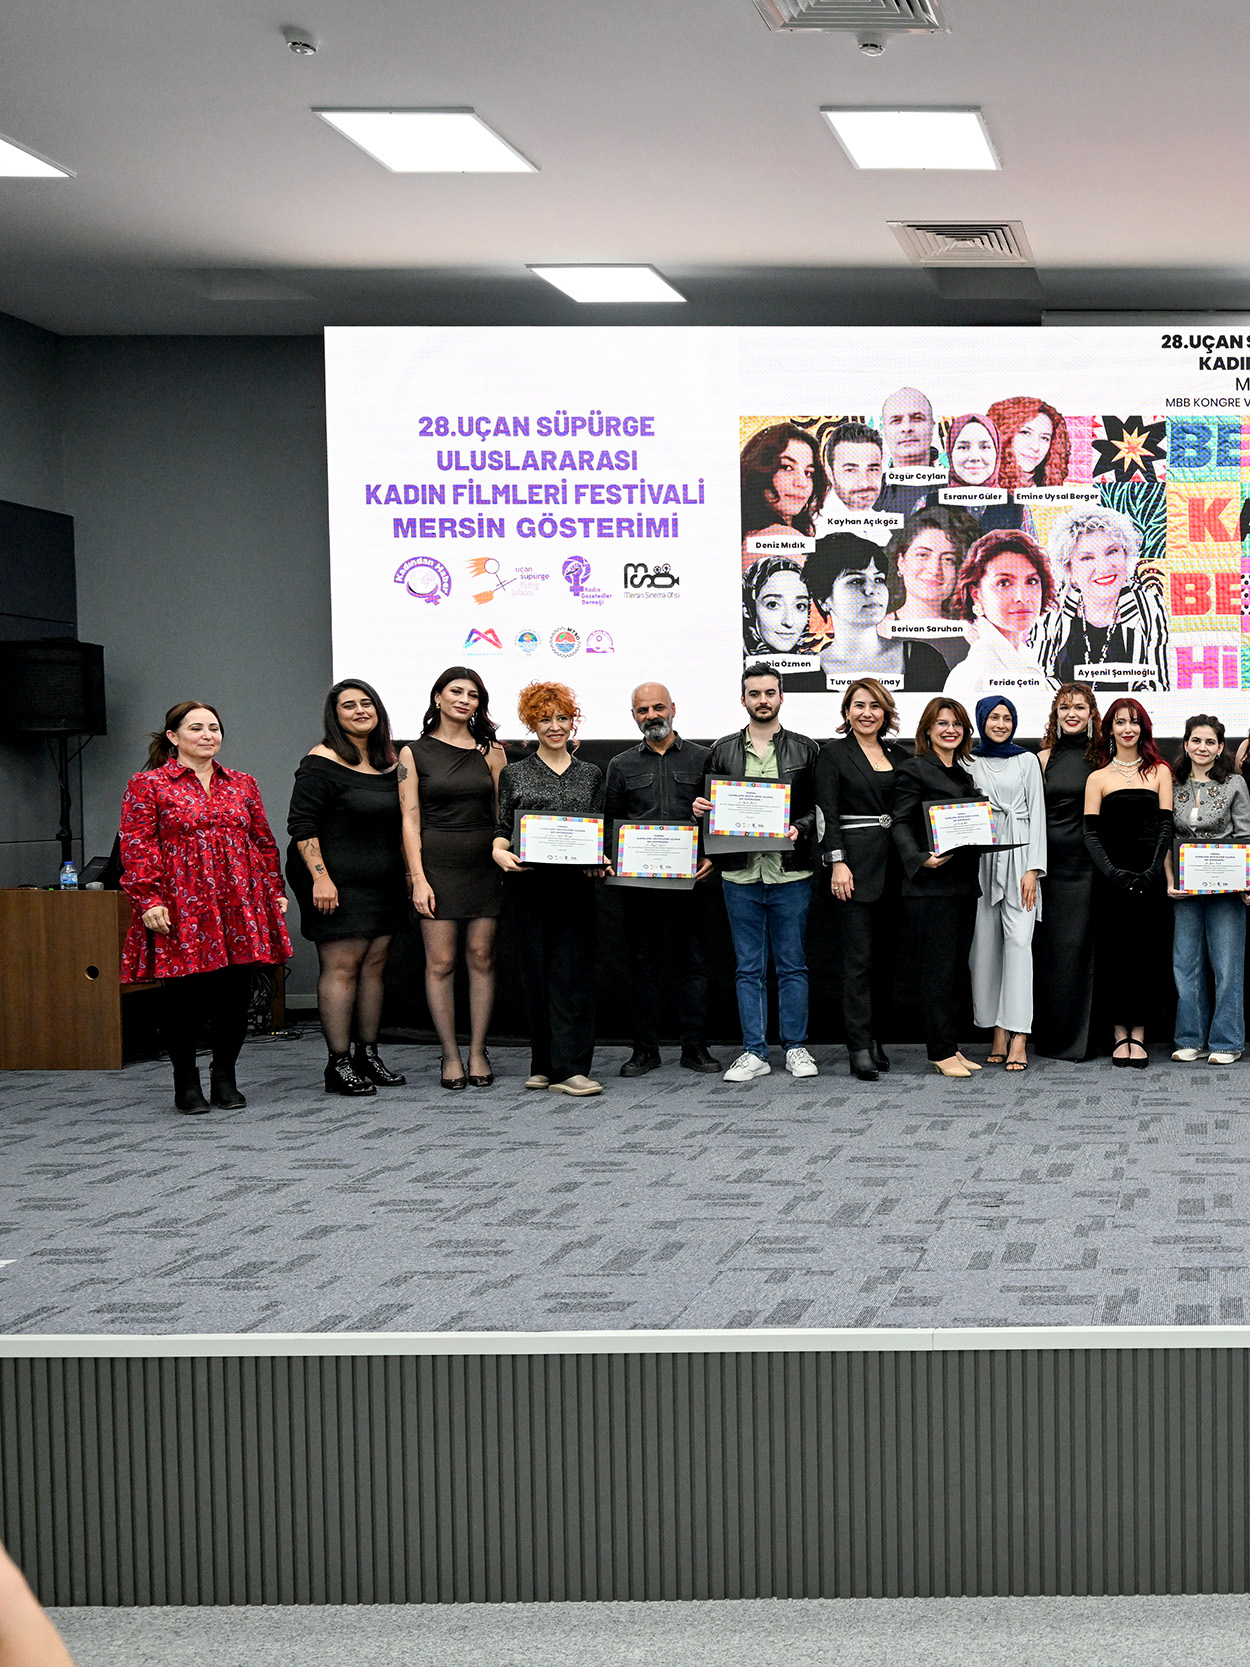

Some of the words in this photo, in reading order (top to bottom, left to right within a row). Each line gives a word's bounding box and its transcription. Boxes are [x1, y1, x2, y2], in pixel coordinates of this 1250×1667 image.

[1161, 334, 1244, 353] 28.UÇAN
[1166, 398, 1191, 408] MBB
[1193, 398, 1241, 408] KONGRE
[419, 415, 530, 442] 28.UÇAN
[536, 410, 655, 437] SÜPÜRGE
[436, 450, 638, 471] ULUSLARARASI
[889, 472, 914, 481] Özgür
[916, 472, 946, 481] Ceylan
[365, 484, 446, 505] KADIN
[453, 478, 568, 505] FİLMLERİ
[574, 478, 705, 504] FESTİVALİ
[980, 492, 1002, 500] Güler
[1045, 492, 1069, 502] Uysal
[1070, 492, 1099, 502] Berger
[393, 513, 506, 538] MERSİN
[516, 513, 679, 538] GÖSTERİMİ
[827, 518, 861, 527] Kayhan
[864, 517, 898, 527] Açıkgöz
[781, 541, 805, 549] Mıdık
[781, 658, 811, 667] Özmen
[1078, 668, 1110, 678] Ayşenil
[1112, 668, 1156, 678] Şamlıoğlu
[877, 678, 901, 687] ünay
[1017, 678, 1040, 687] Çetin
